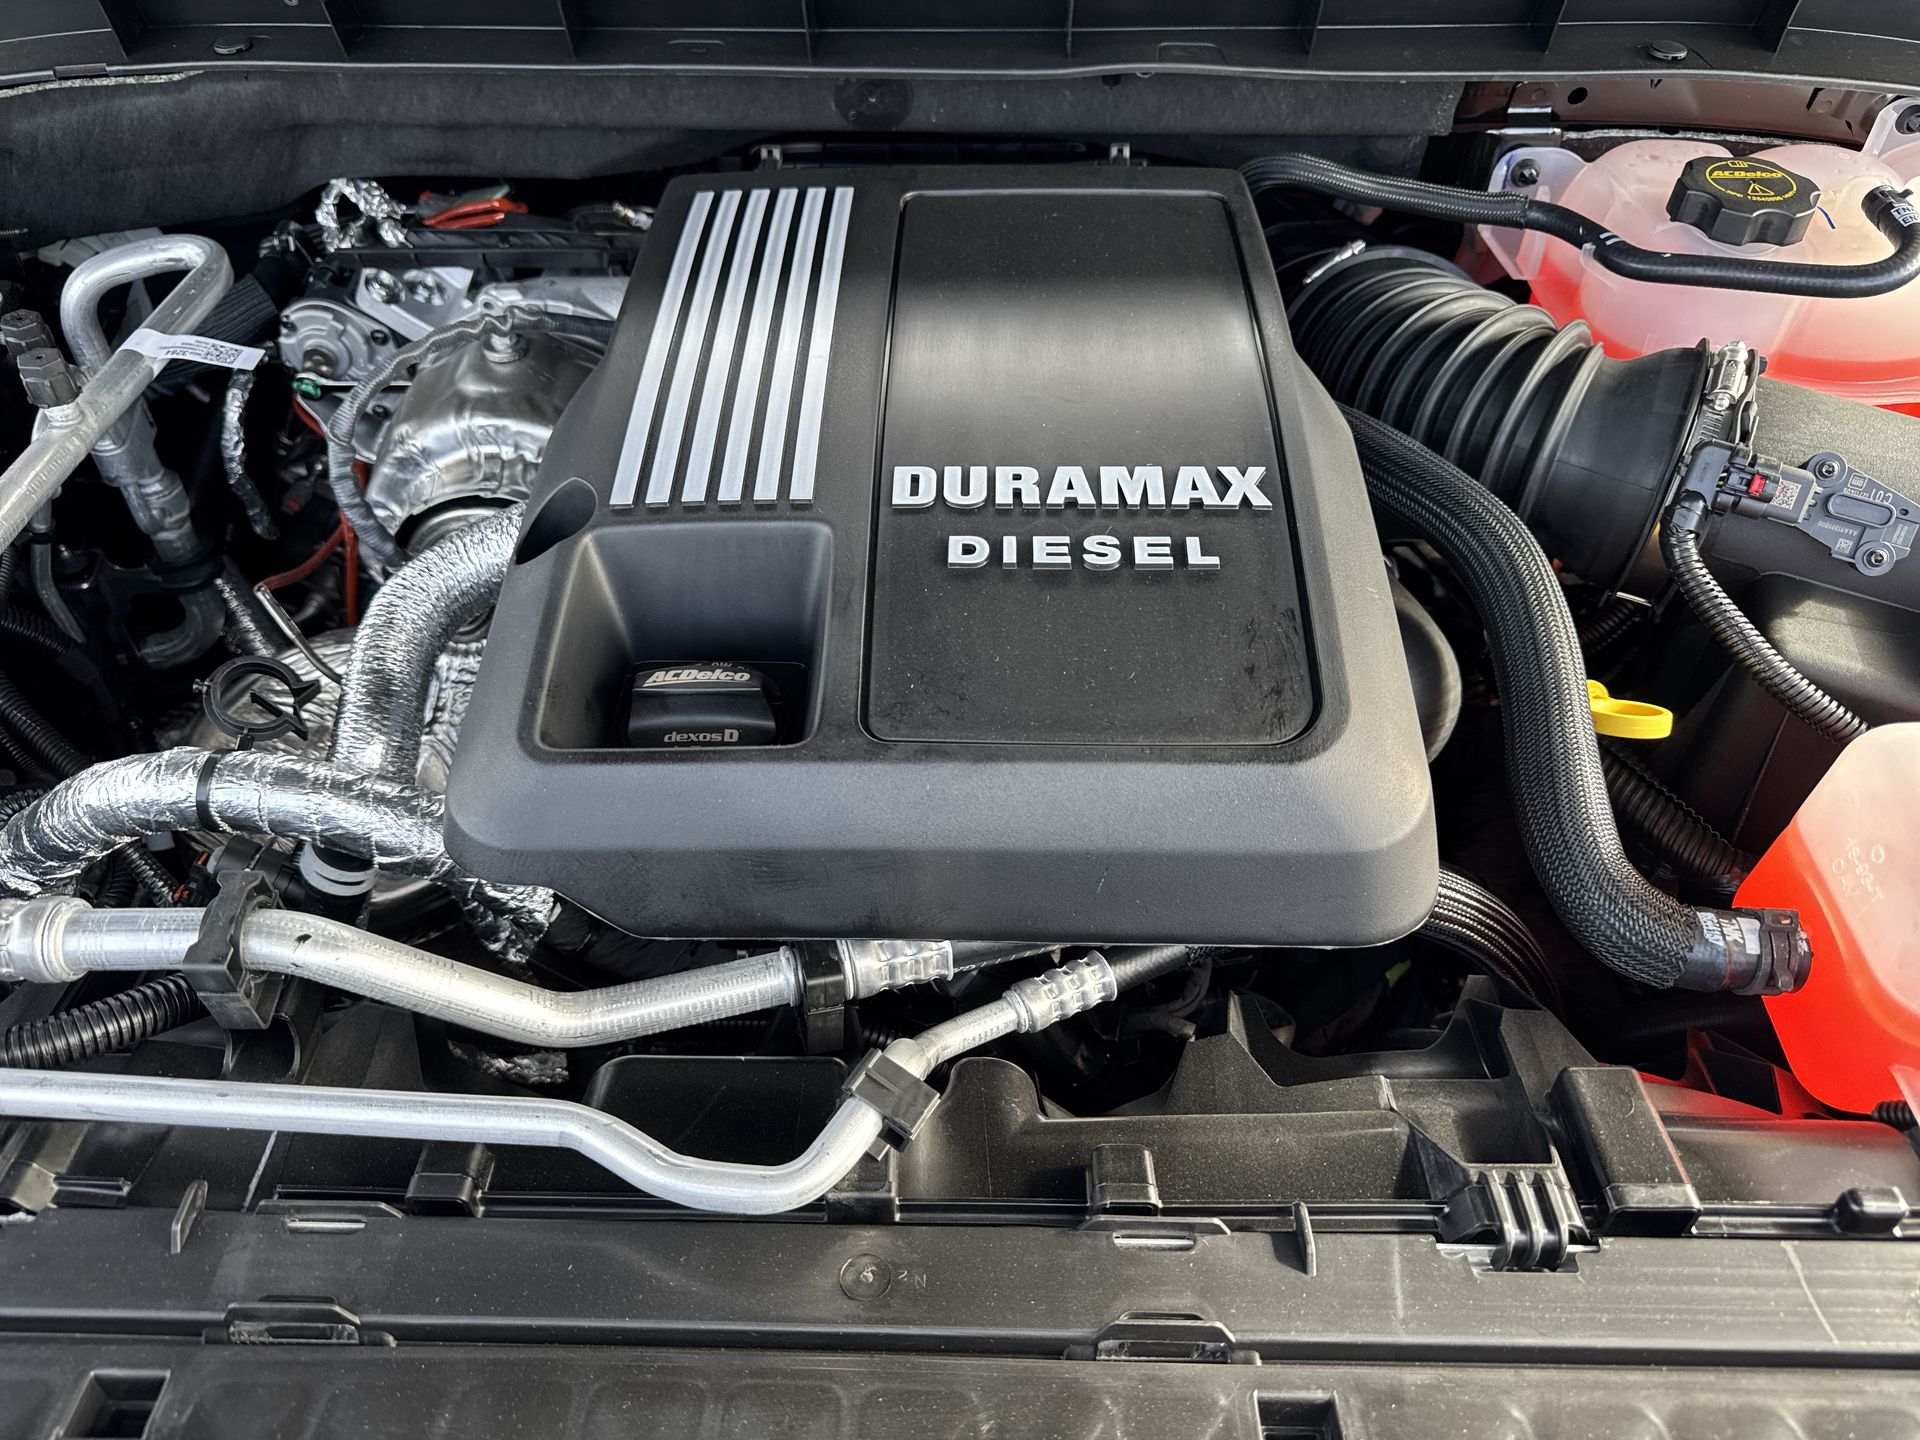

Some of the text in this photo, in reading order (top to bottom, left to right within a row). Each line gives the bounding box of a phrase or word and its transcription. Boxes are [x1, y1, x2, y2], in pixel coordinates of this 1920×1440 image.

[1711, 170, 1783, 178] ACDelco
[892, 465, 1273, 510] DURAMAX
[947, 535, 1221, 571] DIESEL
[644, 668, 751, 684] ACDelco
[664, 728, 740, 743] dexosD
